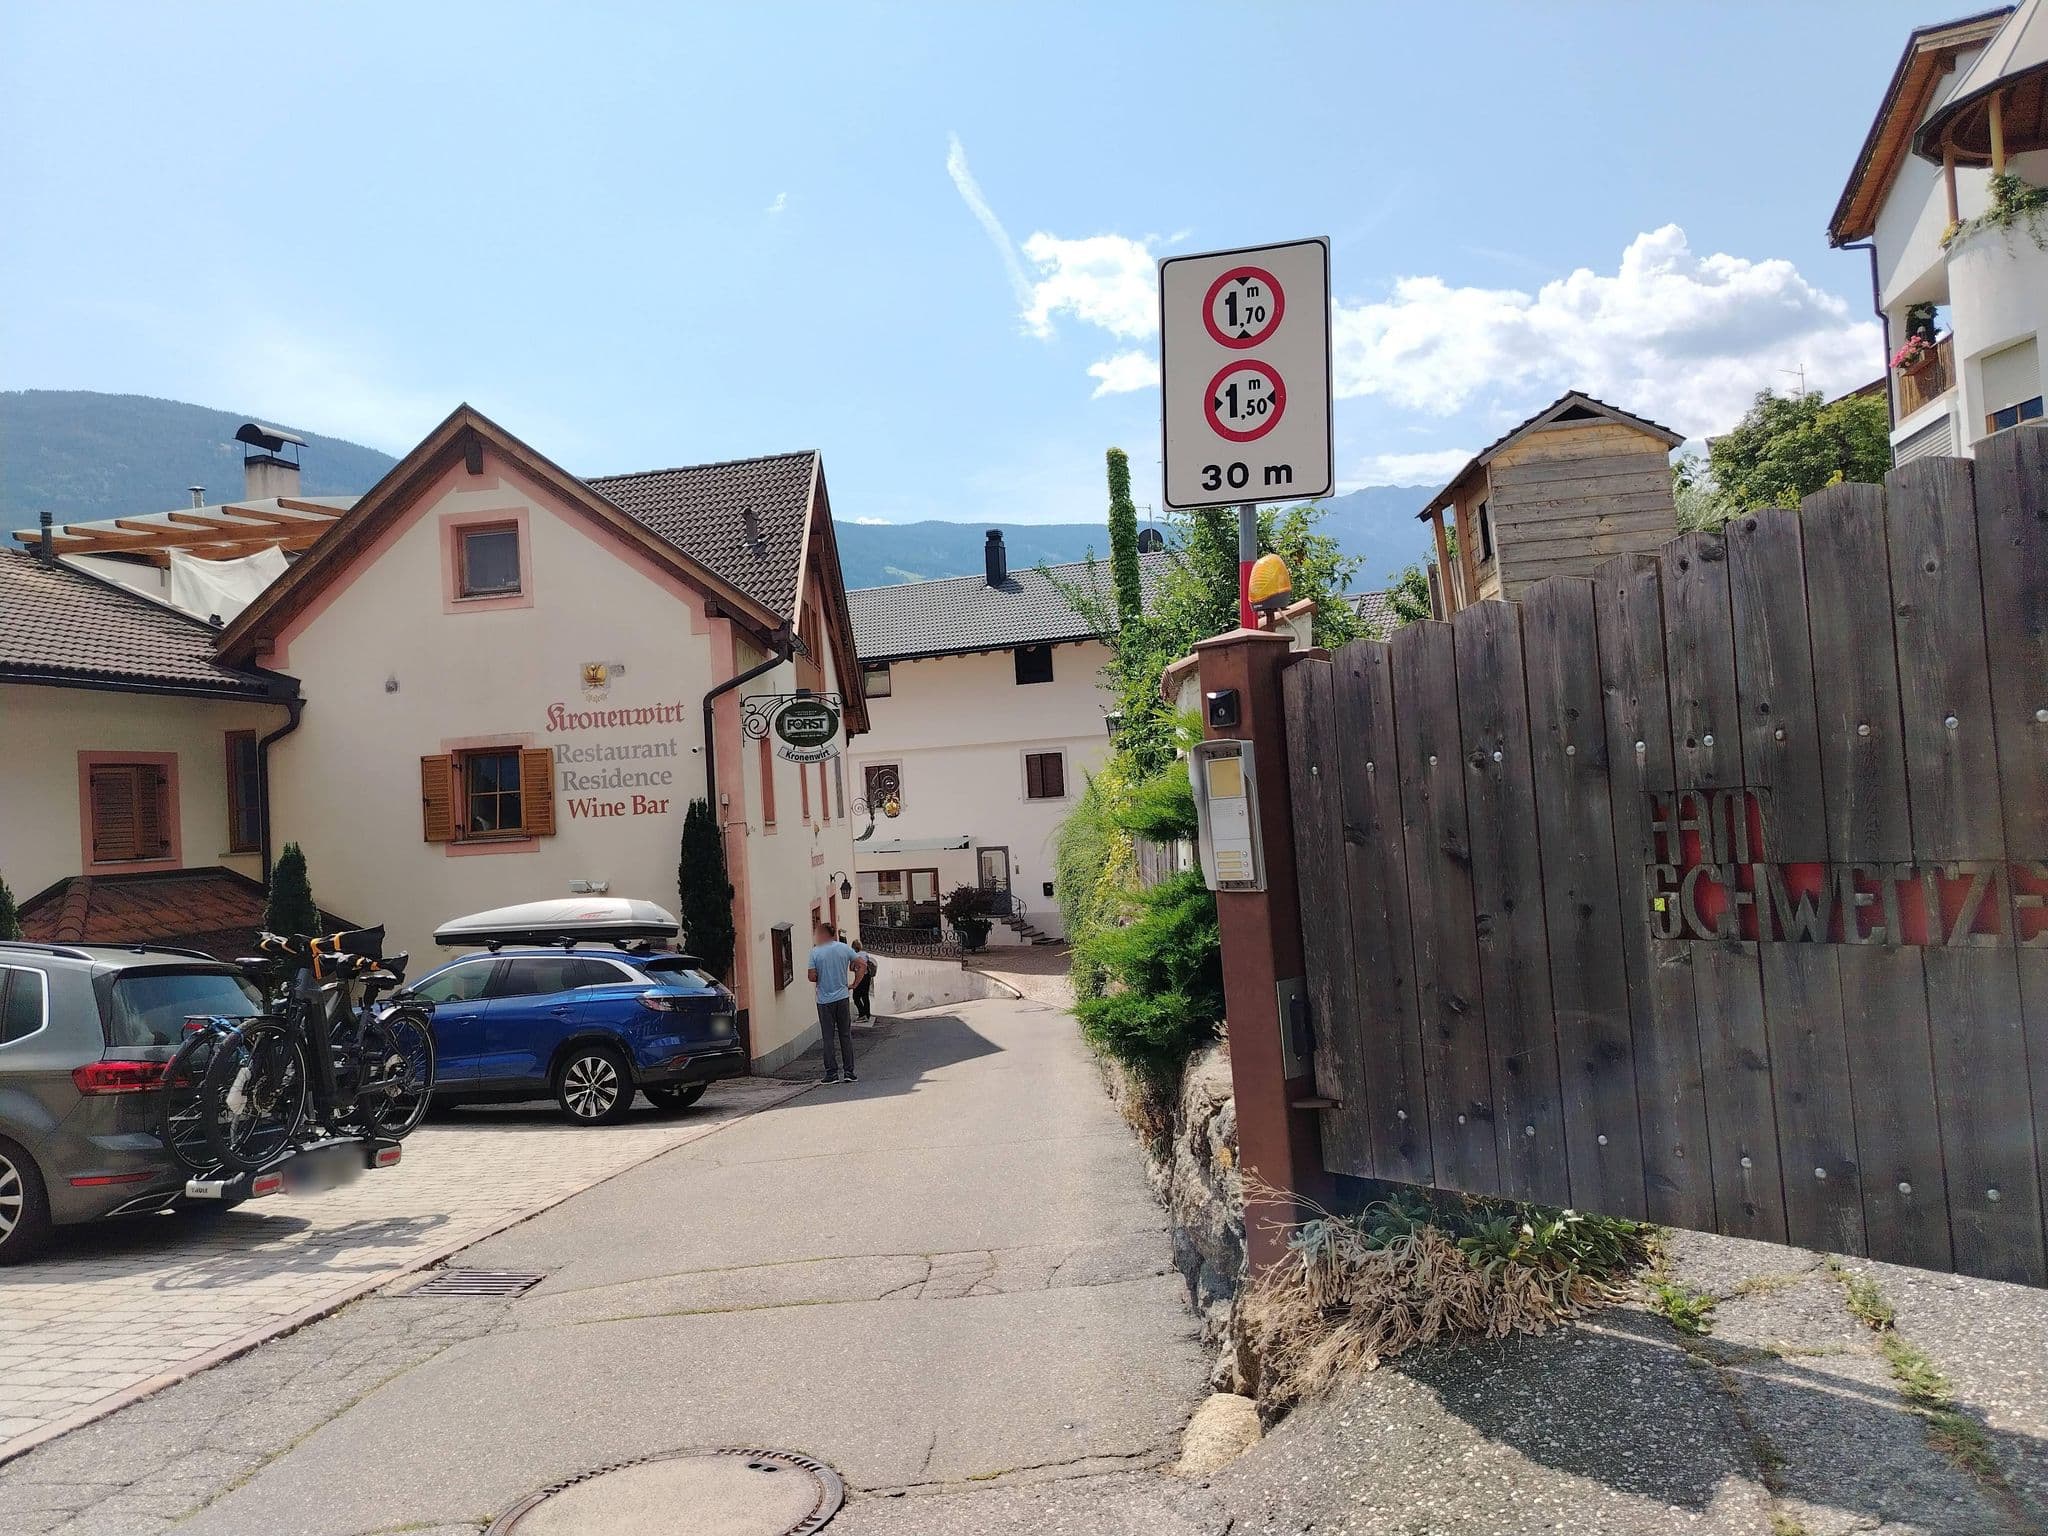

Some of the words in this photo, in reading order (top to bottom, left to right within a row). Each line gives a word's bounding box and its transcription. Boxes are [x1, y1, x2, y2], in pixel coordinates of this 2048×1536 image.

[1225, 291, 1265, 328] 1,70
[1246, 286, 1259, 298] m
[1225, 383, 1267, 420] 1,50
[1248, 378, 1261, 390] m
[1201, 462, 1249, 491] 30
[1264, 463, 1293, 486] m
[546, 700, 685, 732] Kronenwirt
[787, 718, 826, 731] FORST
[555, 738, 678, 765] Restaurant
[786, 749, 831, 761] Kronenwirt
[562, 768, 673, 792] Residence
[567, 797, 626, 819] Wine
[631, 794, 670, 815] Bar
